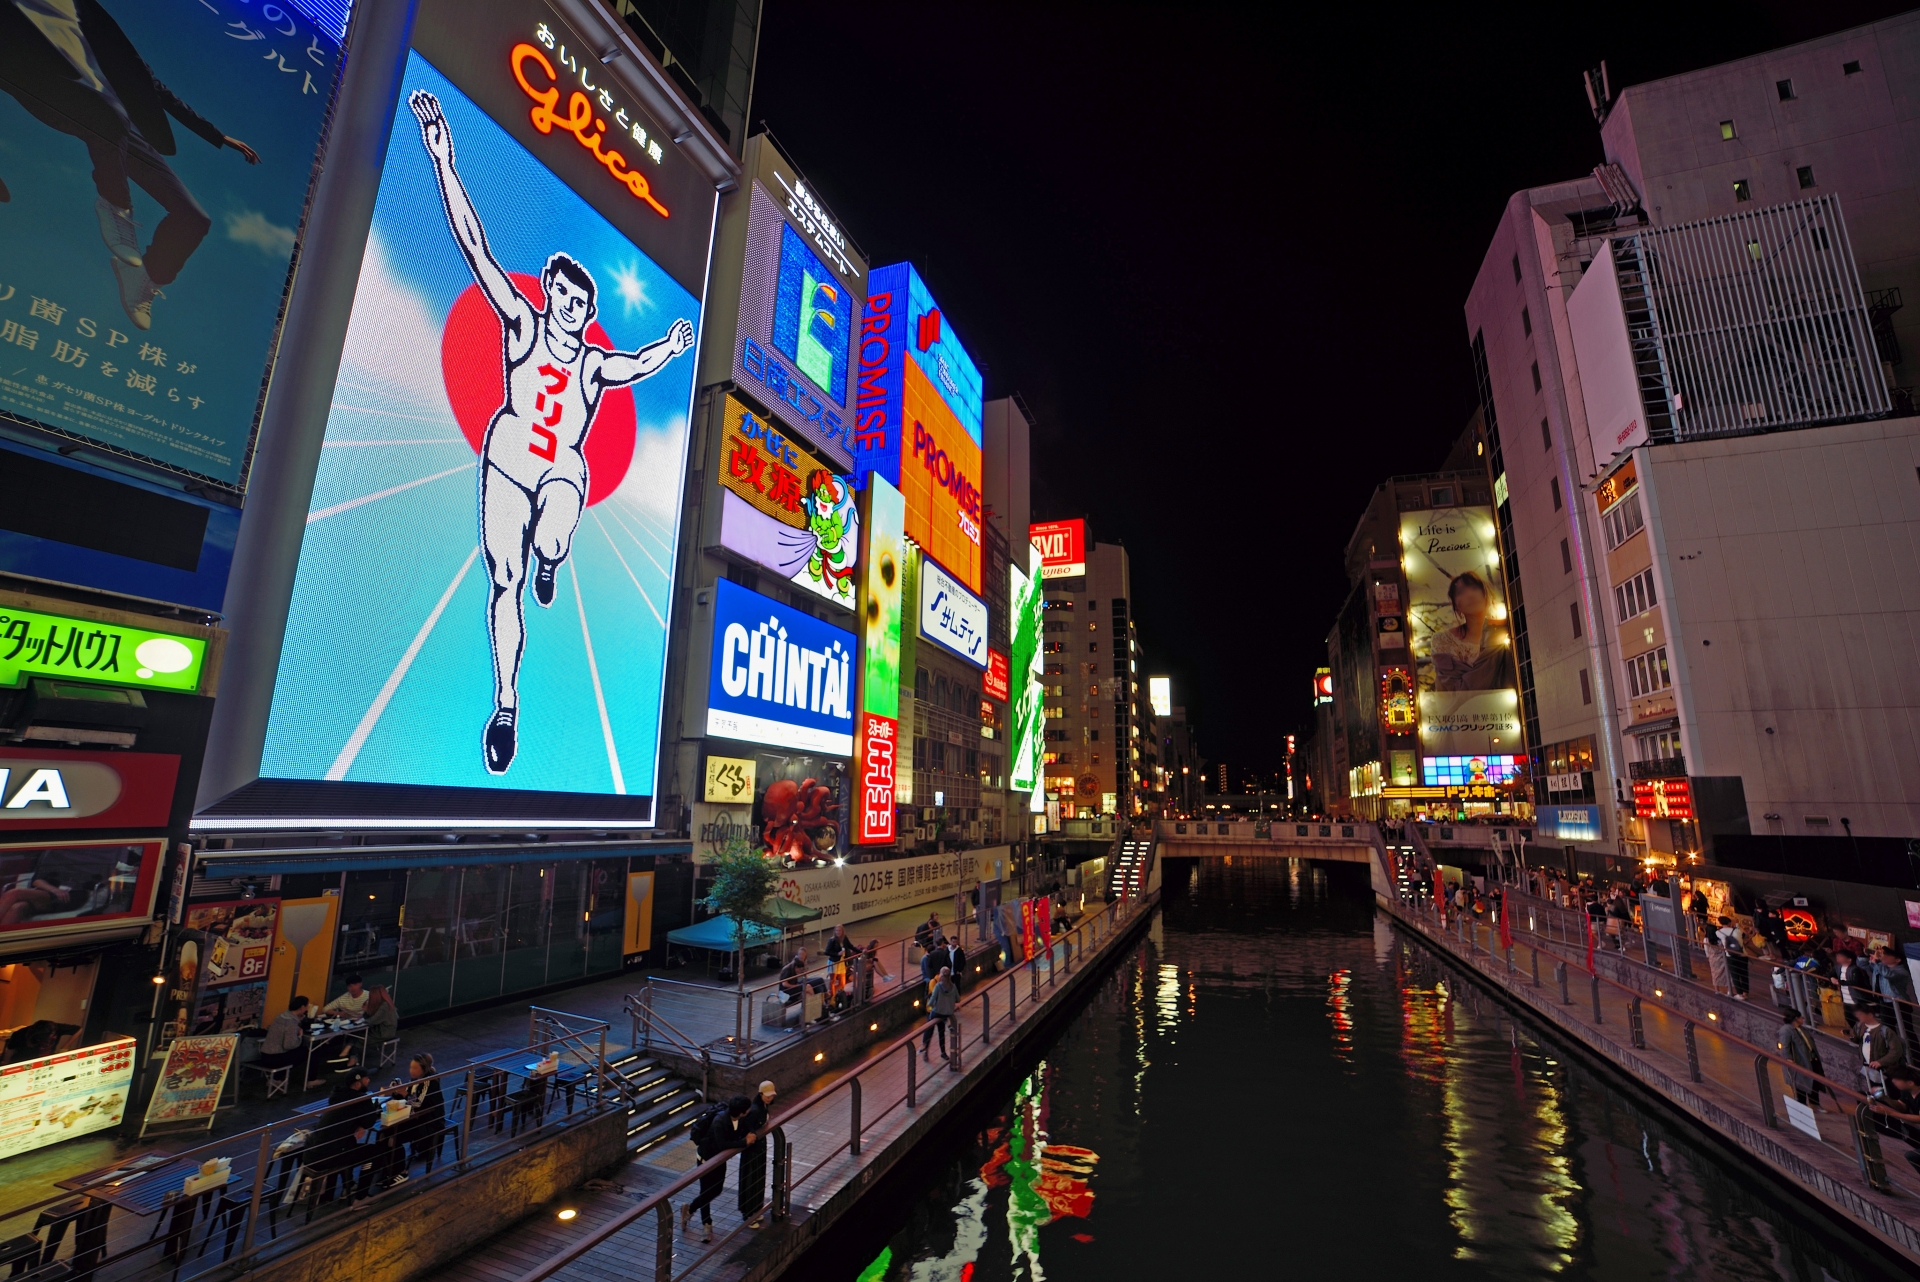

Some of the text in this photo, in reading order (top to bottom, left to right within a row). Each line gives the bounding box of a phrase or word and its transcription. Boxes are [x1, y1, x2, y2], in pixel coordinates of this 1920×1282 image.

[239, 0, 325, 67] のと
[536, 22, 663, 165] おいしさと健康
[511, 43, 670, 218] Glico
[0, 317, 205, 411] 脂肪を減らす
[857, 292, 892, 450] PROMISE
[528, 362, 572, 463] グリコ
[171, 423, 226, 447] ドリンクタイプ
[741, 411, 798, 469] かぜに
[730, 435, 802, 514] 改源
[913, 419, 981, 525] PROMISE
[957, 508, 980, 547] プロミス
[1418, 523, 1456, 536] Life is
[1041, 567, 1071, 578] UJIBO
[0, 768, 71, 808] A
[716, 763, 746, 797] くくる
[804, 880, 841, 893] OSAKA-KANSAI
[852, 869, 894, 896] 2025年
[898, 857, 980, 887] 国際博覧会を大阪関西へ
[804, 894, 821, 906] JAPAN
[243, 958, 263, 975] 8F
[171, 1047, 229, 1062] たこやき
